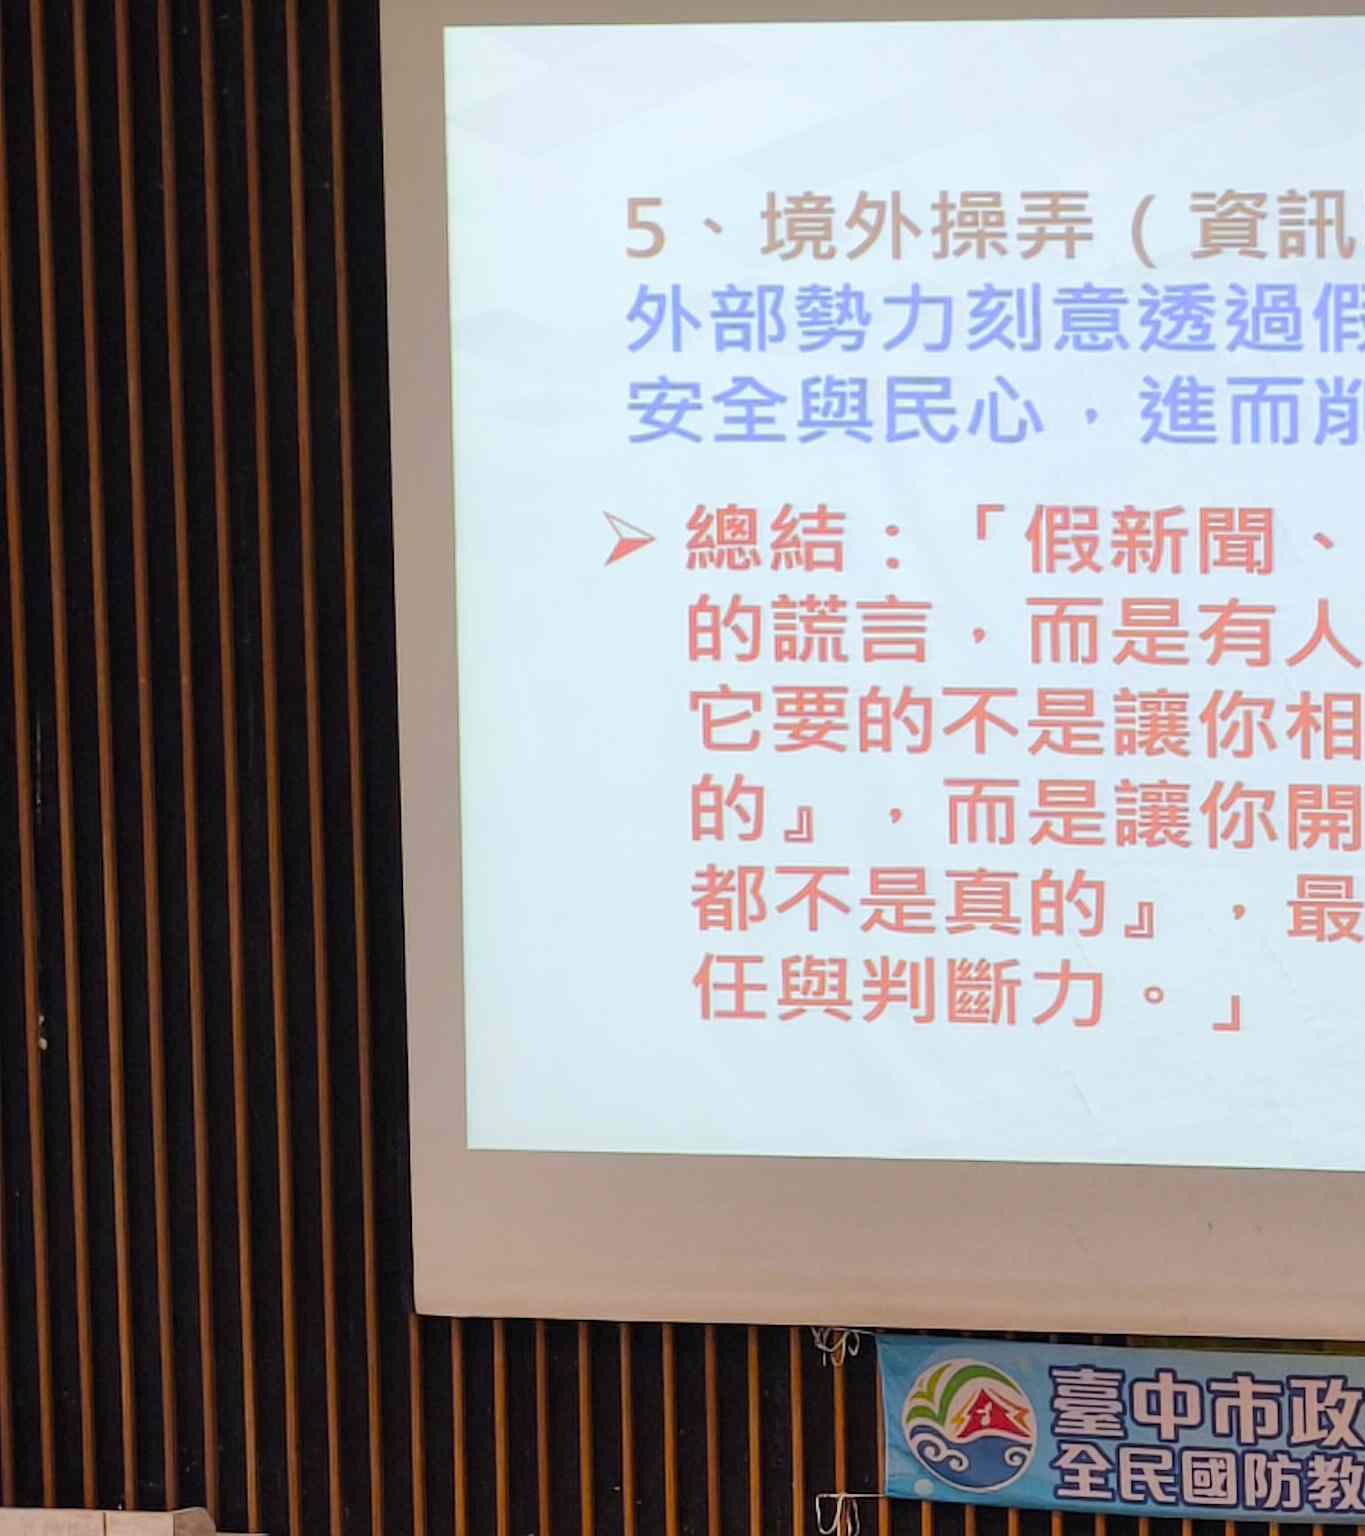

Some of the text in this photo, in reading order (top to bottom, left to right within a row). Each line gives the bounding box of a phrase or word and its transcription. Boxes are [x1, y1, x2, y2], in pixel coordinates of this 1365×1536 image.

[692, 952, 1240, 1032] 任與判斷力。」
